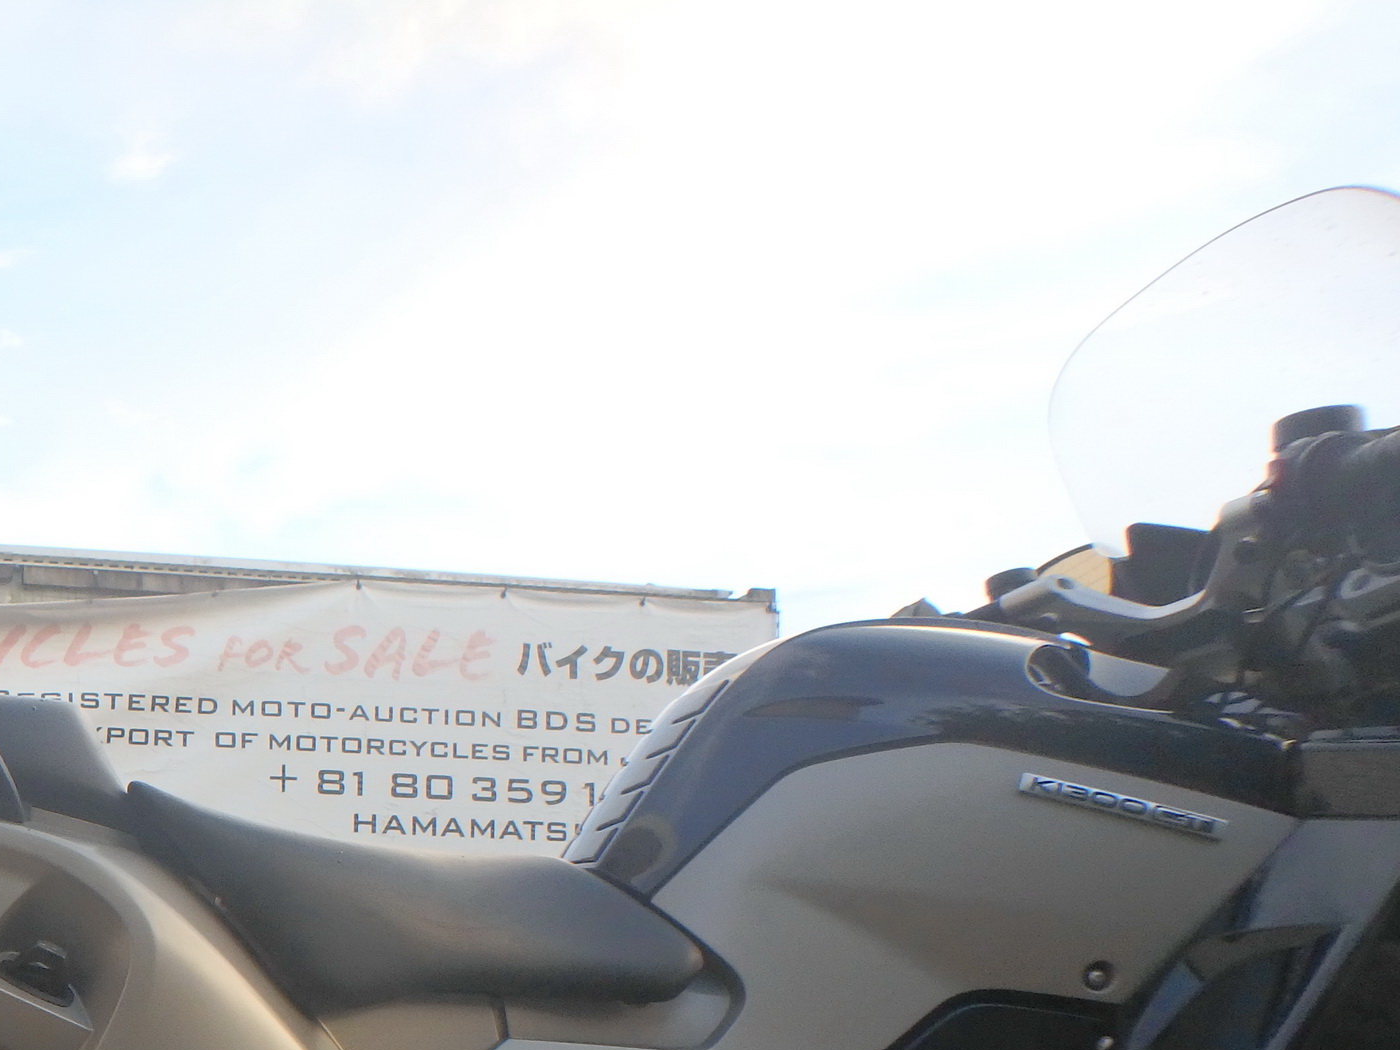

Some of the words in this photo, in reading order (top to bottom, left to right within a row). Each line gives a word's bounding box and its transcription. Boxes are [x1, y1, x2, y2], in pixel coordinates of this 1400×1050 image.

[216, 634, 311, 673] FOR
[323, 624, 501, 682] SALE
[231, 699, 502, 728] MOTO-AUCTION
[516, 709, 597, 733] BDS
[214, 731, 259, 749] OF
[269, 732, 511, 762] MOTORCYCLES
[522, 746, 609, 766] FROM
[316, 769, 364, 798] 81
[390, 772, 454, 800] 80
[353, 813, 583, 843] HAMAMATS
